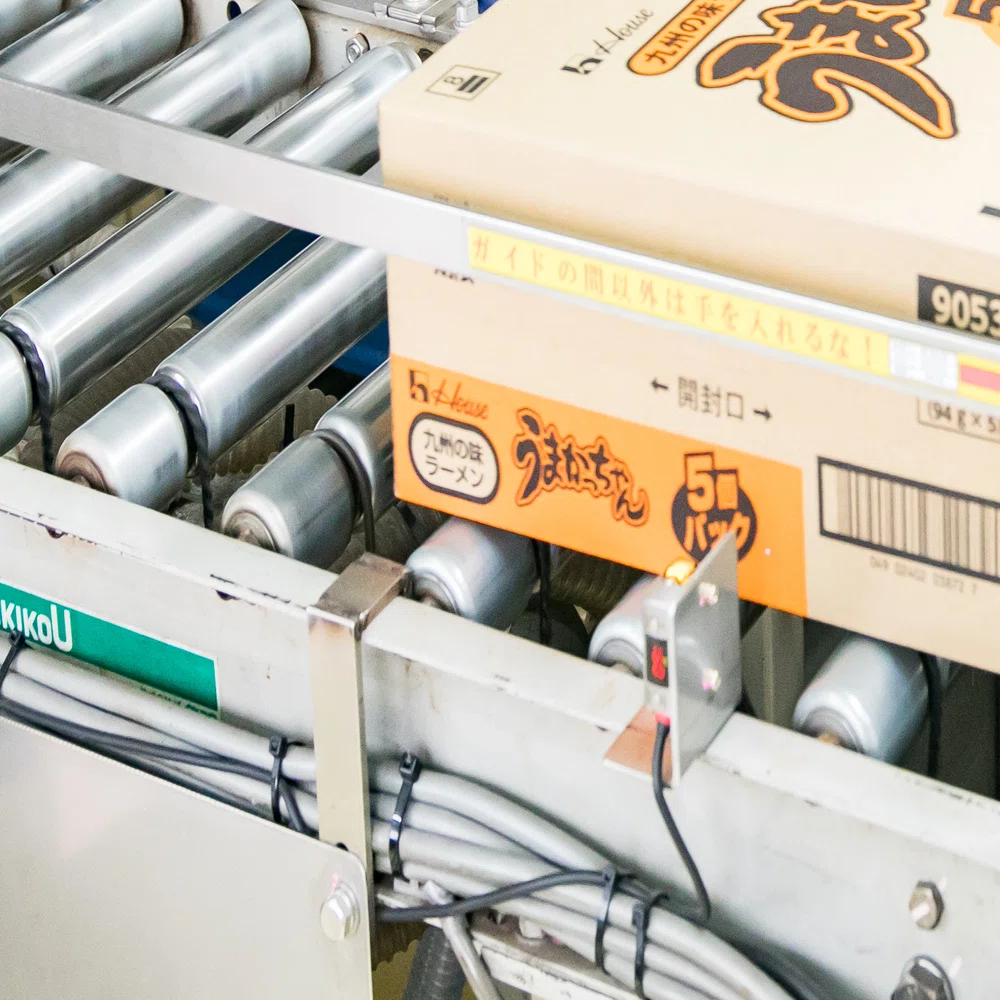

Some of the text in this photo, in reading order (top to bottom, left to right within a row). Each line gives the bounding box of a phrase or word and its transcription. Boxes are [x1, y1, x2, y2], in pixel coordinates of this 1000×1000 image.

[677, 375, 745, 421] 開封口
[423, 429, 485, 466] 九州の味
[511, 406, 650, 527] うまかっちゃん
[424, 454, 486, 488] ラーメン
[0, 599, 73, 652] KIKOU
